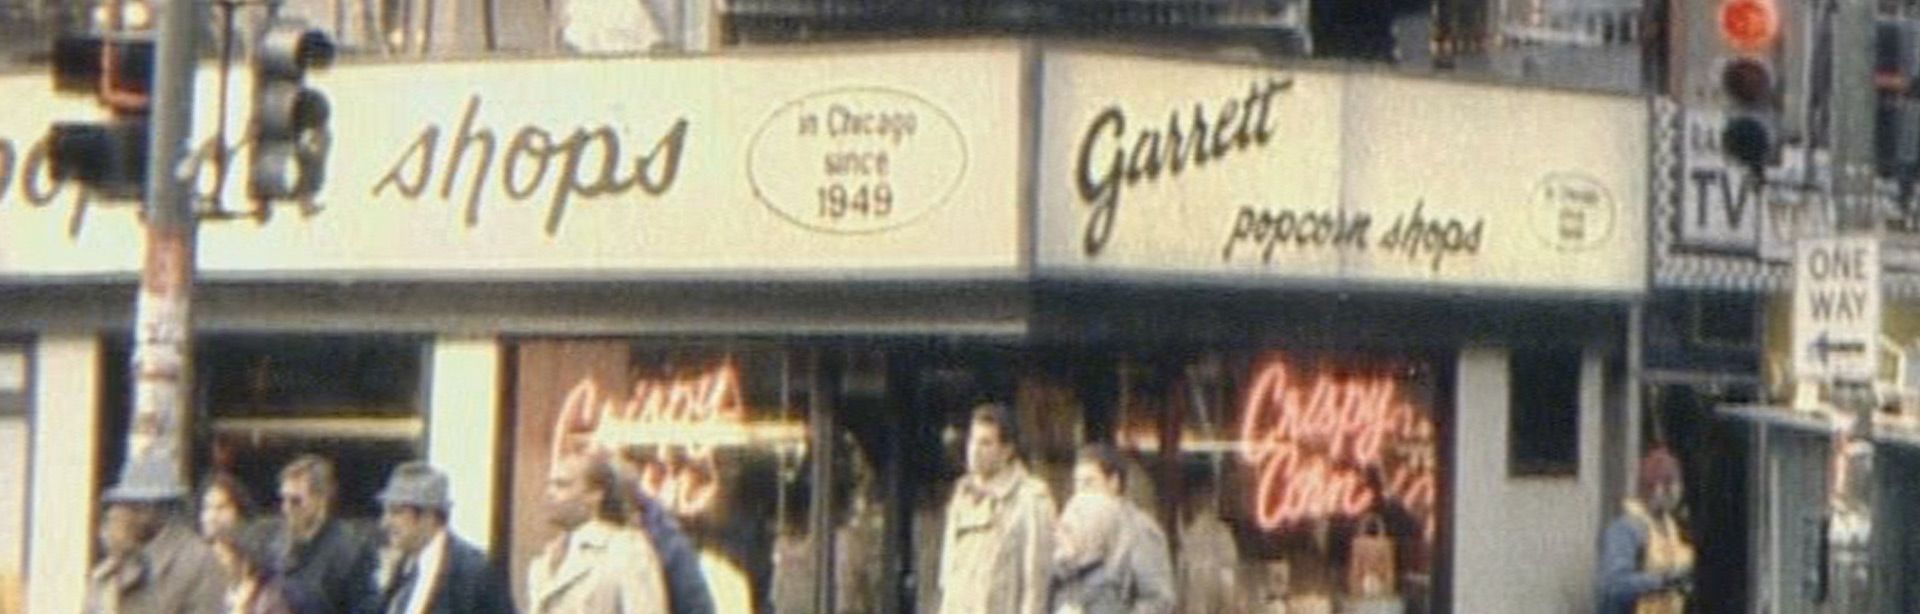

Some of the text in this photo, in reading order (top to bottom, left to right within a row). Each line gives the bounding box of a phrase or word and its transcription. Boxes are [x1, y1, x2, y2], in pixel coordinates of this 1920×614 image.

[798, 103, 918, 146] in Chicago
[372, 94, 688, 237] shops
[824, 150, 889, 176] since
[1075, 77, 1294, 257] Garrett
[817, 183, 894, 218] 1949
[1690, 167, 1755, 230] TV
[1223, 203, 1373, 264] popcorn
[1379, 197, 1484, 269] shops
[1808, 247, 1868, 281] ONE
[1810, 289, 1869, 322] WAY
